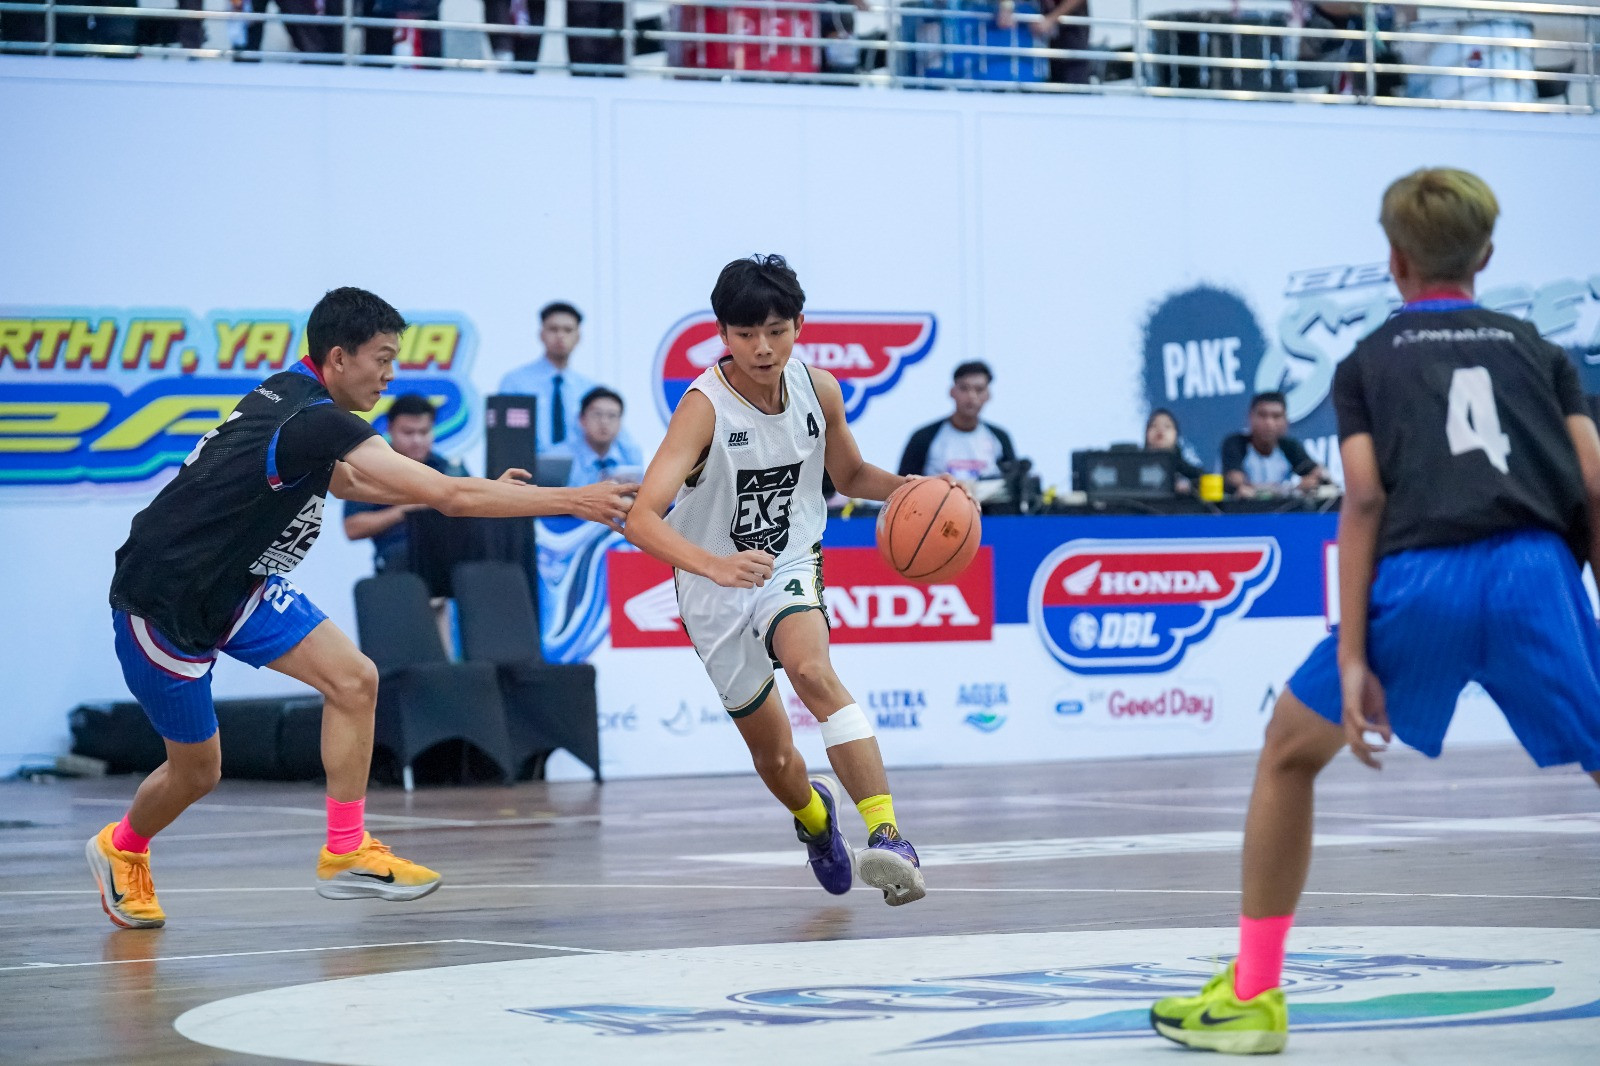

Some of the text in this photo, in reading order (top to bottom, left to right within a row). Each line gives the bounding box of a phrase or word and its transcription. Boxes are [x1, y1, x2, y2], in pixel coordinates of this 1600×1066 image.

[121, 319, 199, 374] IT,
[216, 321, 293, 370] YA
[792, 343, 875, 369] NDA
[1161, 336, 1246, 401] PAKE
[728, 431, 749, 442] DBL
[805, 411, 820, 439] 4
[1445, 365, 1512, 475] 4
[783, 578, 805, 596] 4
[1100, 570, 1222, 596] HONDA
[823, 584, 980, 629] NDA
[1097, 611, 1161, 649] DBL
